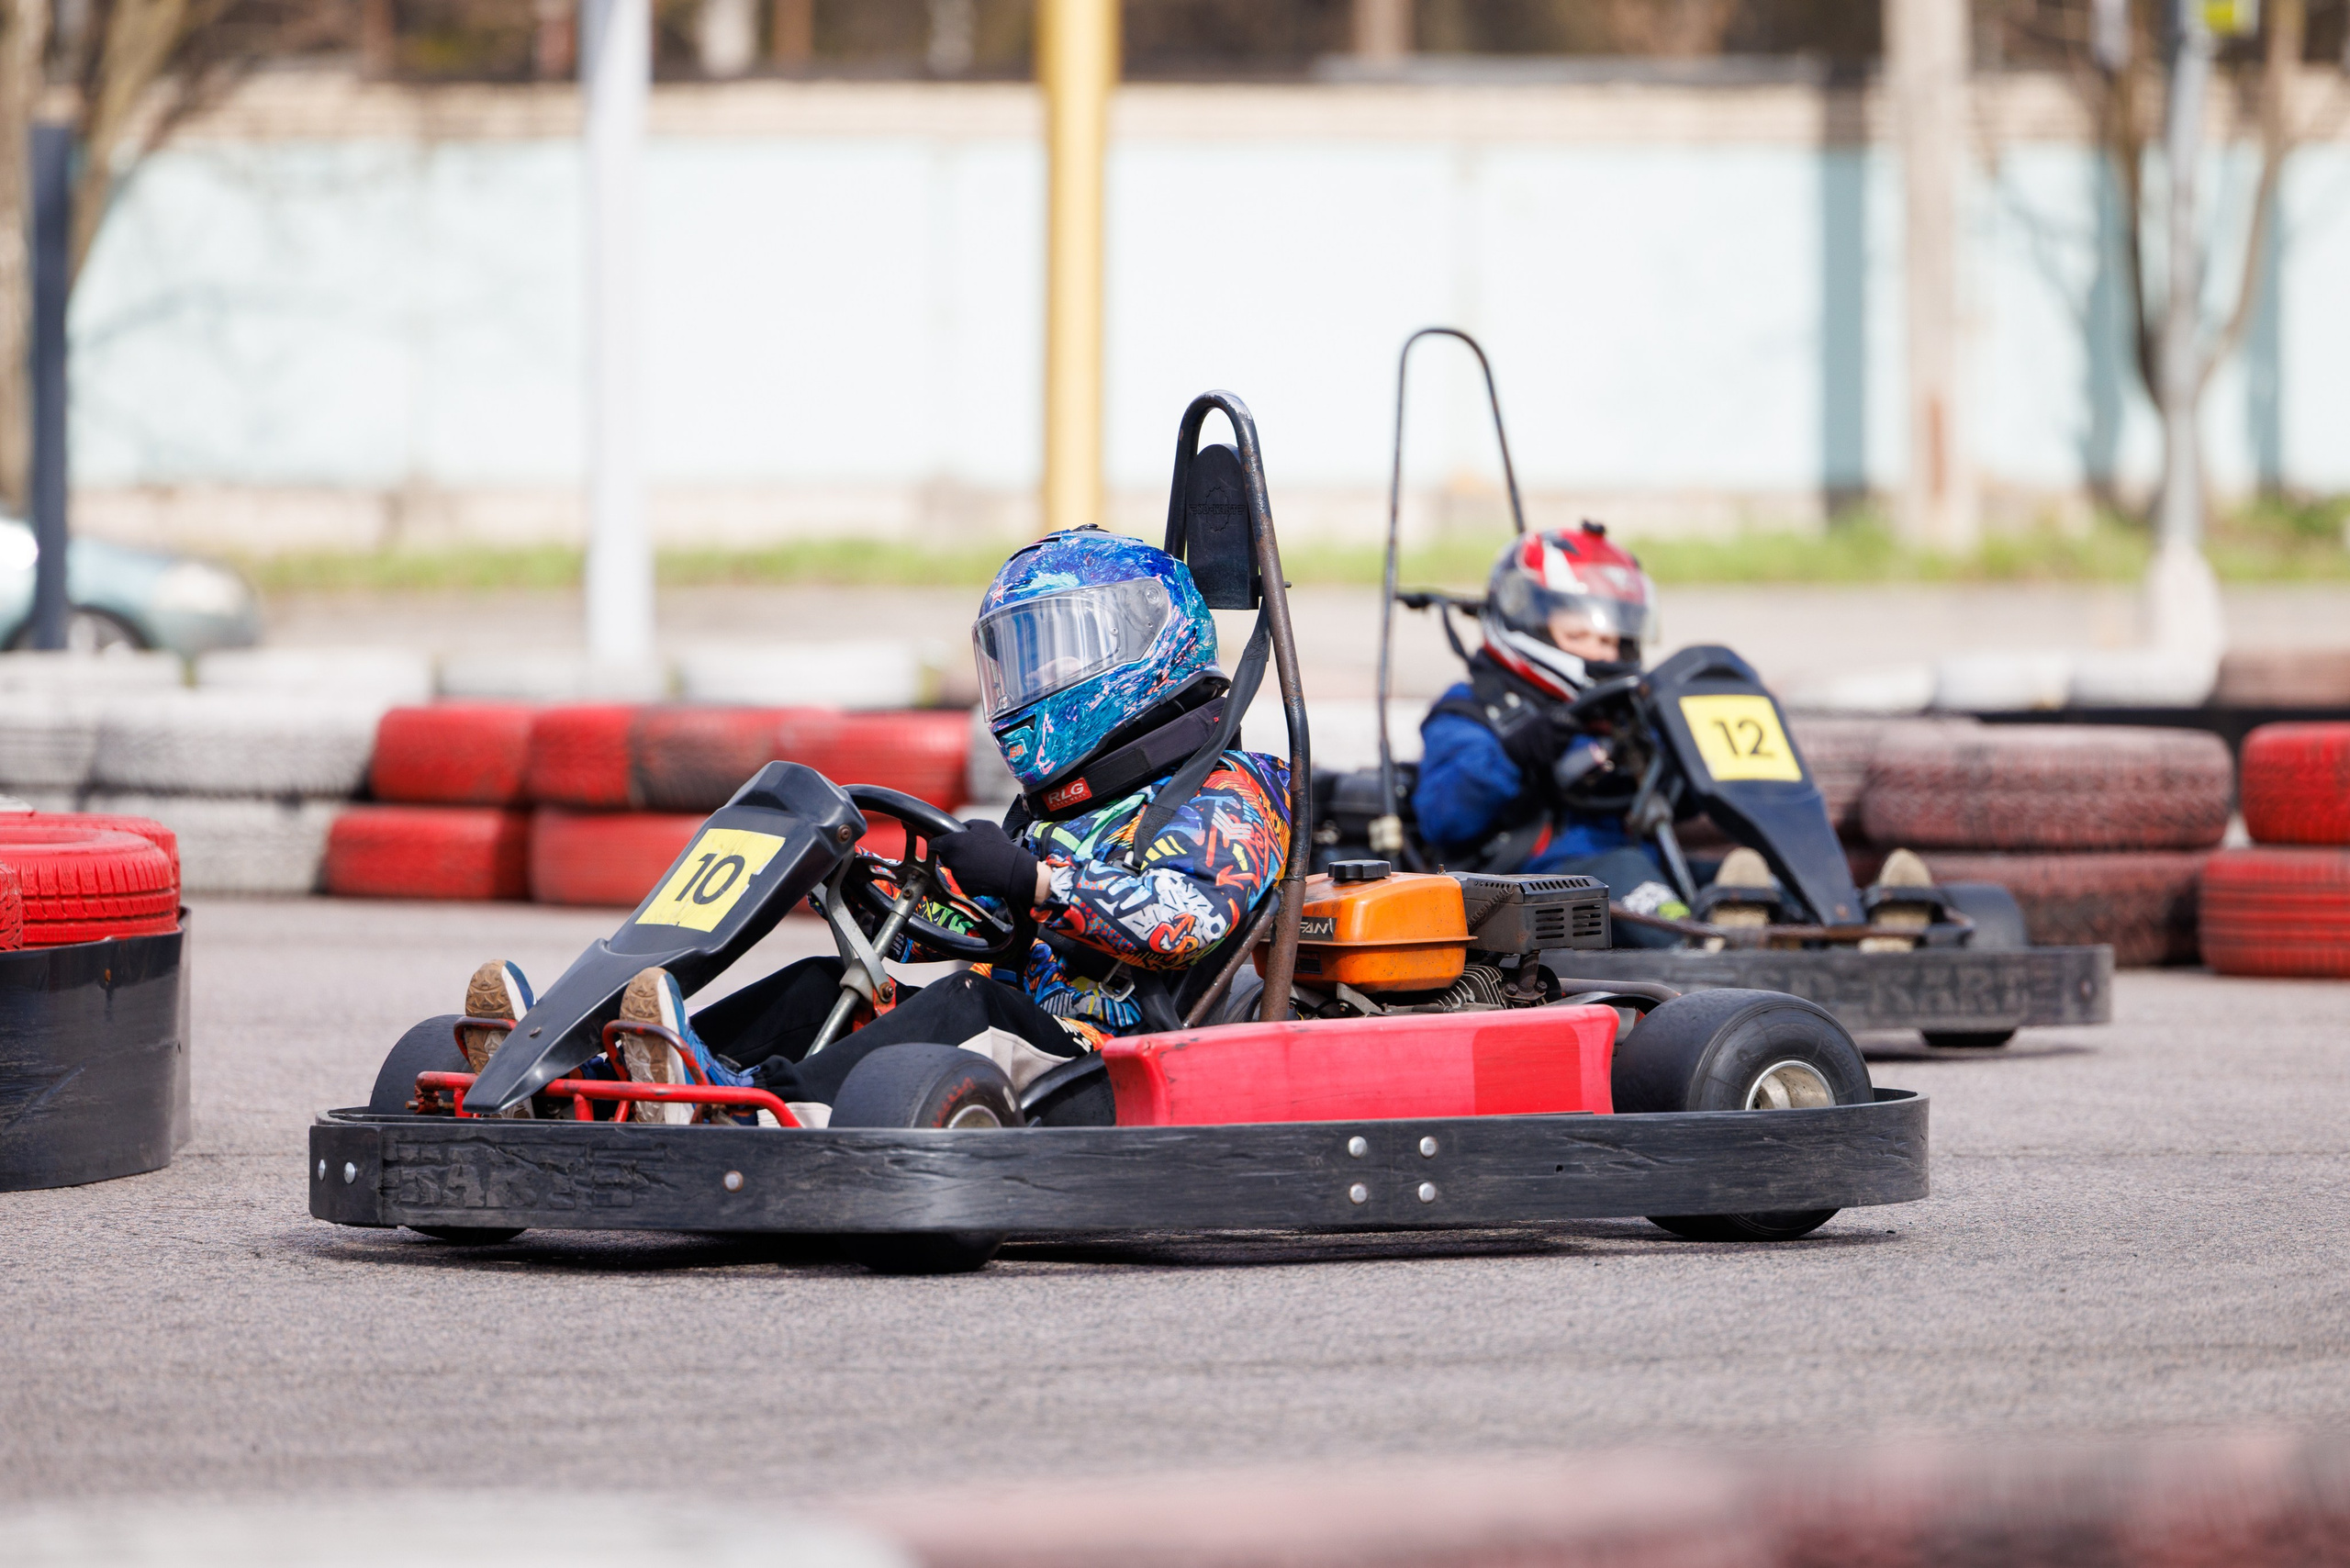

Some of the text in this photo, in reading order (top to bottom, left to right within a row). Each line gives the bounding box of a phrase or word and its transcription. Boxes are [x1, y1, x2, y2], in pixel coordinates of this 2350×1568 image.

[1713, 720, 1774, 757] 12
[1047, 782, 1084, 804] RLG
[675, 853, 745, 905] 10
